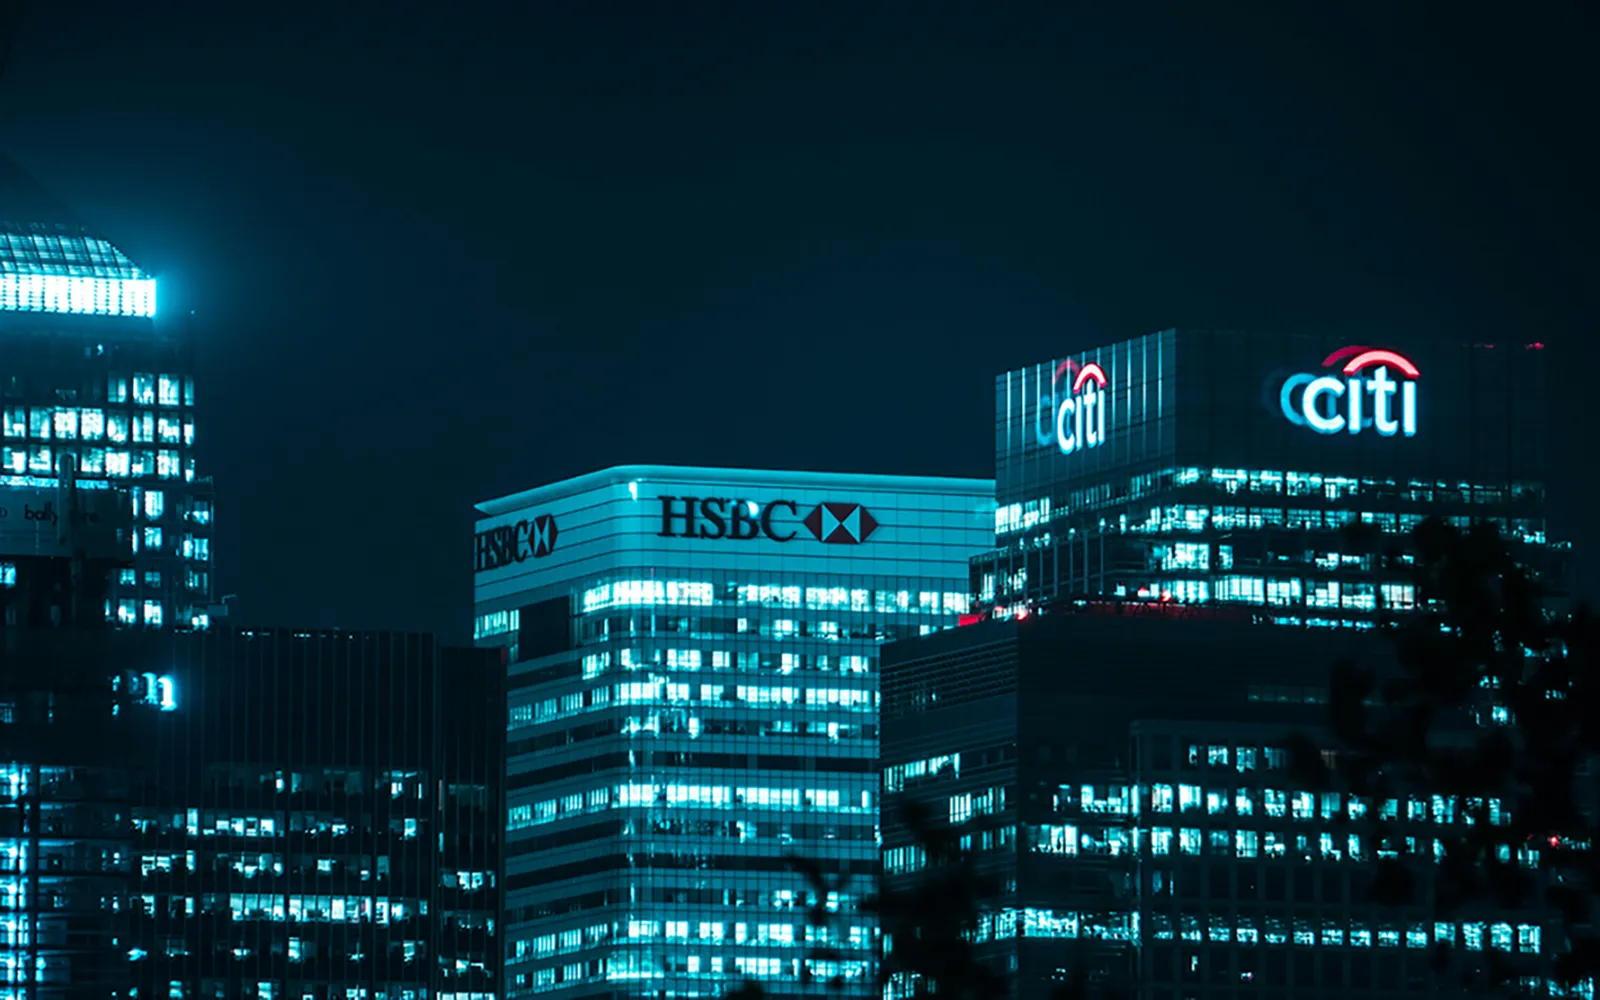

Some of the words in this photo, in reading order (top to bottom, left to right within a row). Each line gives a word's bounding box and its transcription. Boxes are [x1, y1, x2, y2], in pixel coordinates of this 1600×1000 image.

[1056, 370, 1107, 456] citi
[1301, 357, 1420, 438] citi
[474, 521, 528, 571] HSBC
[657, 495, 798, 542] HSBC
